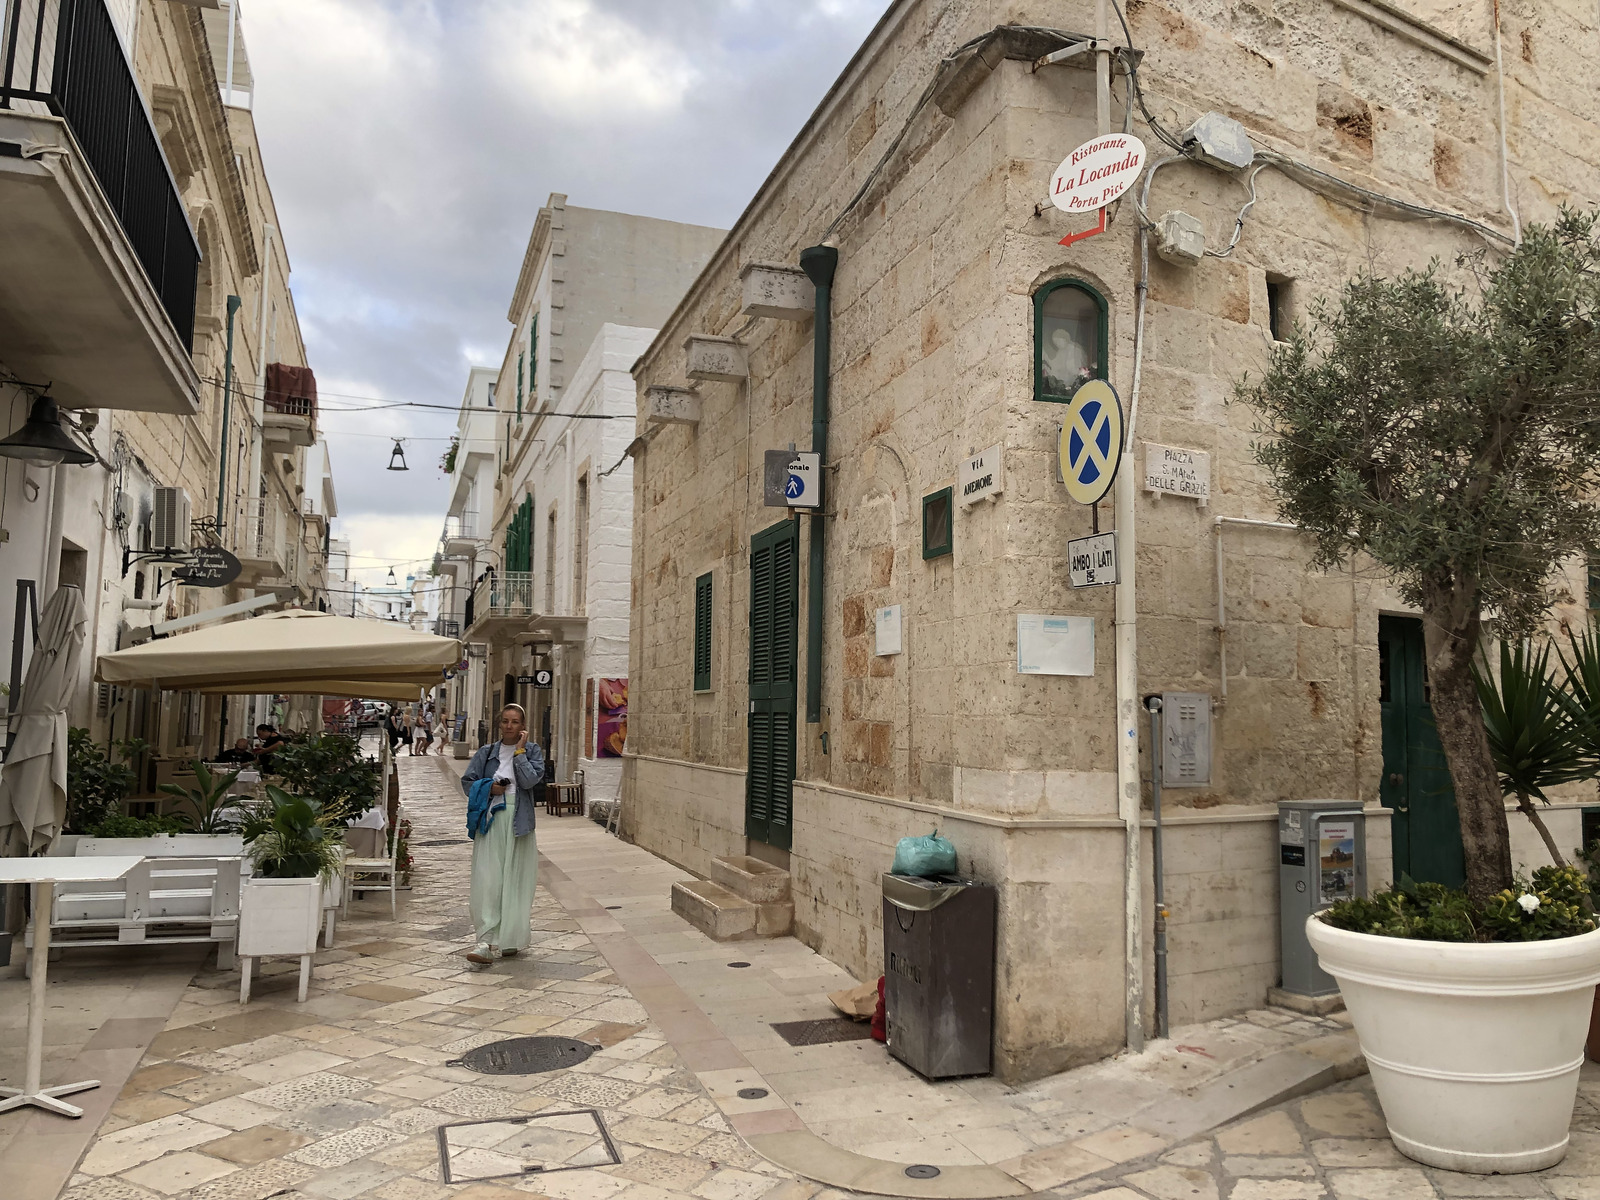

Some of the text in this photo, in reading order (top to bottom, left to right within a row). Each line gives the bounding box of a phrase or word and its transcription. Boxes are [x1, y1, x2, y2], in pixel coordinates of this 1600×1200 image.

[1071, 138, 1127, 166] Ristorante
[1054, 151, 1139, 195] La Locanda
[1068, 196, 1098, 208] Porta
[971, 457, 984, 471] VIA
[1164, 449, 1193, 464] PIAZZA
[1162, 464, 1169, 474] S.
[963, 473, 992, 496] ANEMONE
[1149, 476, 1207, 496] DELLE GRAZIE
[1072, 550, 1113, 572] AMBO I LATI
